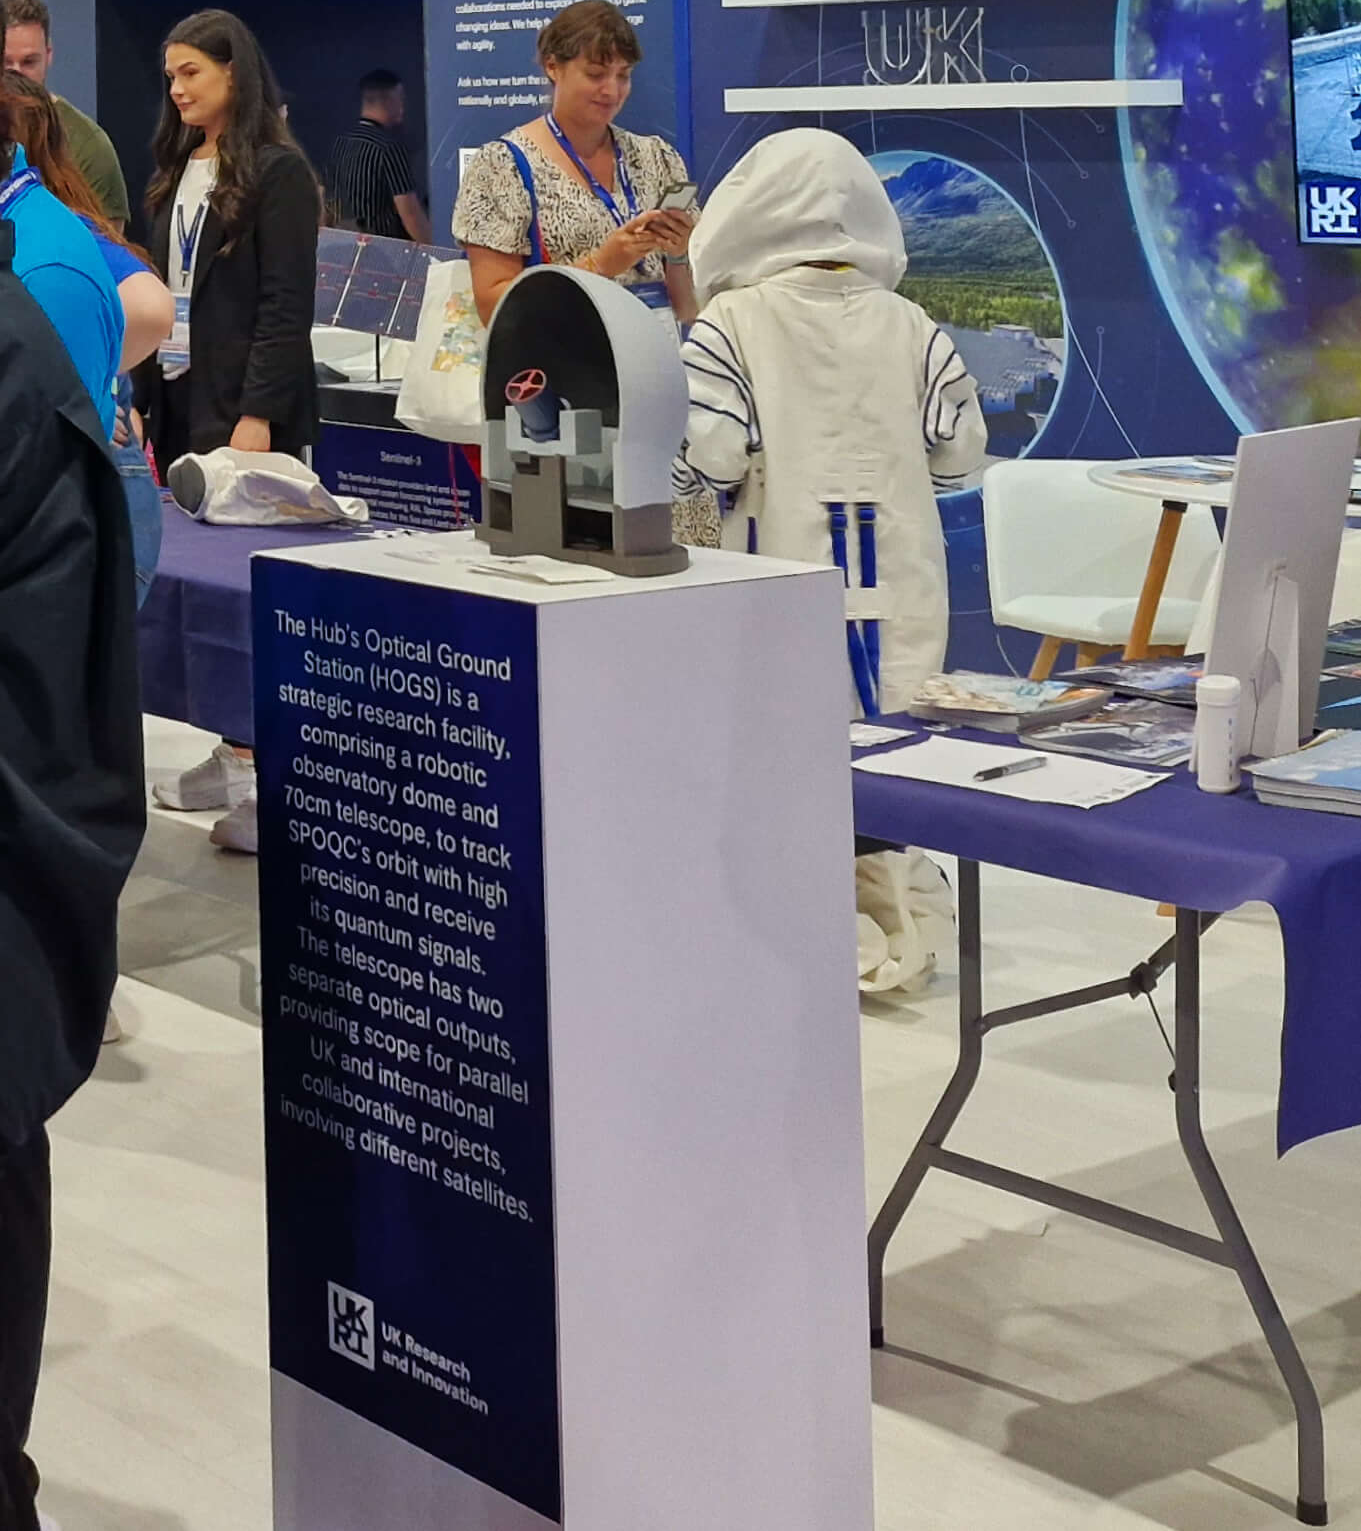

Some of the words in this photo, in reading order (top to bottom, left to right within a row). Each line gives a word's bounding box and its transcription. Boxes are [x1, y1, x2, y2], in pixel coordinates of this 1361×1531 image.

[274, 609, 306, 637] The
[311, 617, 359, 648] Hub's
[364, 628, 431, 663] Optical
[436, 643, 511, 680] Ground
[303, 650, 364, 683] Station
[369, 664, 441, 705] (HOGS)
[446, 681, 462, 707] is
[466, 691, 479, 711] a
[278, 683, 352, 719] strategic
[357, 703, 436, 736] research
[441, 718, 510, 760] facility,
[300, 724, 395, 769] comprising
[401, 748, 411, 767] a
[417, 753, 487, 787] robotic
[284, 784, 331, 816] 70cm
[335, 800, 430, 847] telescope,
[435, 828, 456, 853] to
[461, 836, 511, 869] track
[292, 756, 397, 804] observatory
[402, 782, 456, 816] dome
[461, 802, 498, 828] and
[288, 819, 370, 864] SPOQC's
[375, 850, 418, 879] orbit
[423, 864, 462, 892] with
[467, 872, 507, 906] high
[300, 864, 379, 902] precision
[385, 889, 418, 915] and
[424, 901, 495, 940] receive
[310, 896, 329, 921] its
[334, 909, 412, 949] quantum
[418, 934, 486, 974] signals.
[296, 925, 328, 956] The
[334, 942, 424, 990] telescope
[428, 970, 462, 1004] has
[466, 987, 503, 1018] two
[279, 995, 359, 1044] providing
[363, 1026, 420, 1062] scope
[425, 1043, 453, 1074] for
[458, 1062, 528, 1103] parallel
[288, 963, 363, 1004] separate
[368, 992, 430, 1028] optical
[435, 1017, 516, 1063] outputs,
[310, 1035, 335, 1065] UK
[340, 1053, 373, 1080] and
[378, 1063, 494, 1128] international
[280, 1094, 355, 1150] involving
[359, 1130, 437, 1180] different
[443, 1168, 533, 1221] satellites.
[302, 1072, 416, 1134] collaborative
[422, 1121, 506, 1174] projects,
[382, 1320, 402, 1348] UK
[405, 1332, 471, 1382] Research
[382, 1350, 409, 1374] and
[412, 1360, 489, 1416] Innovation
